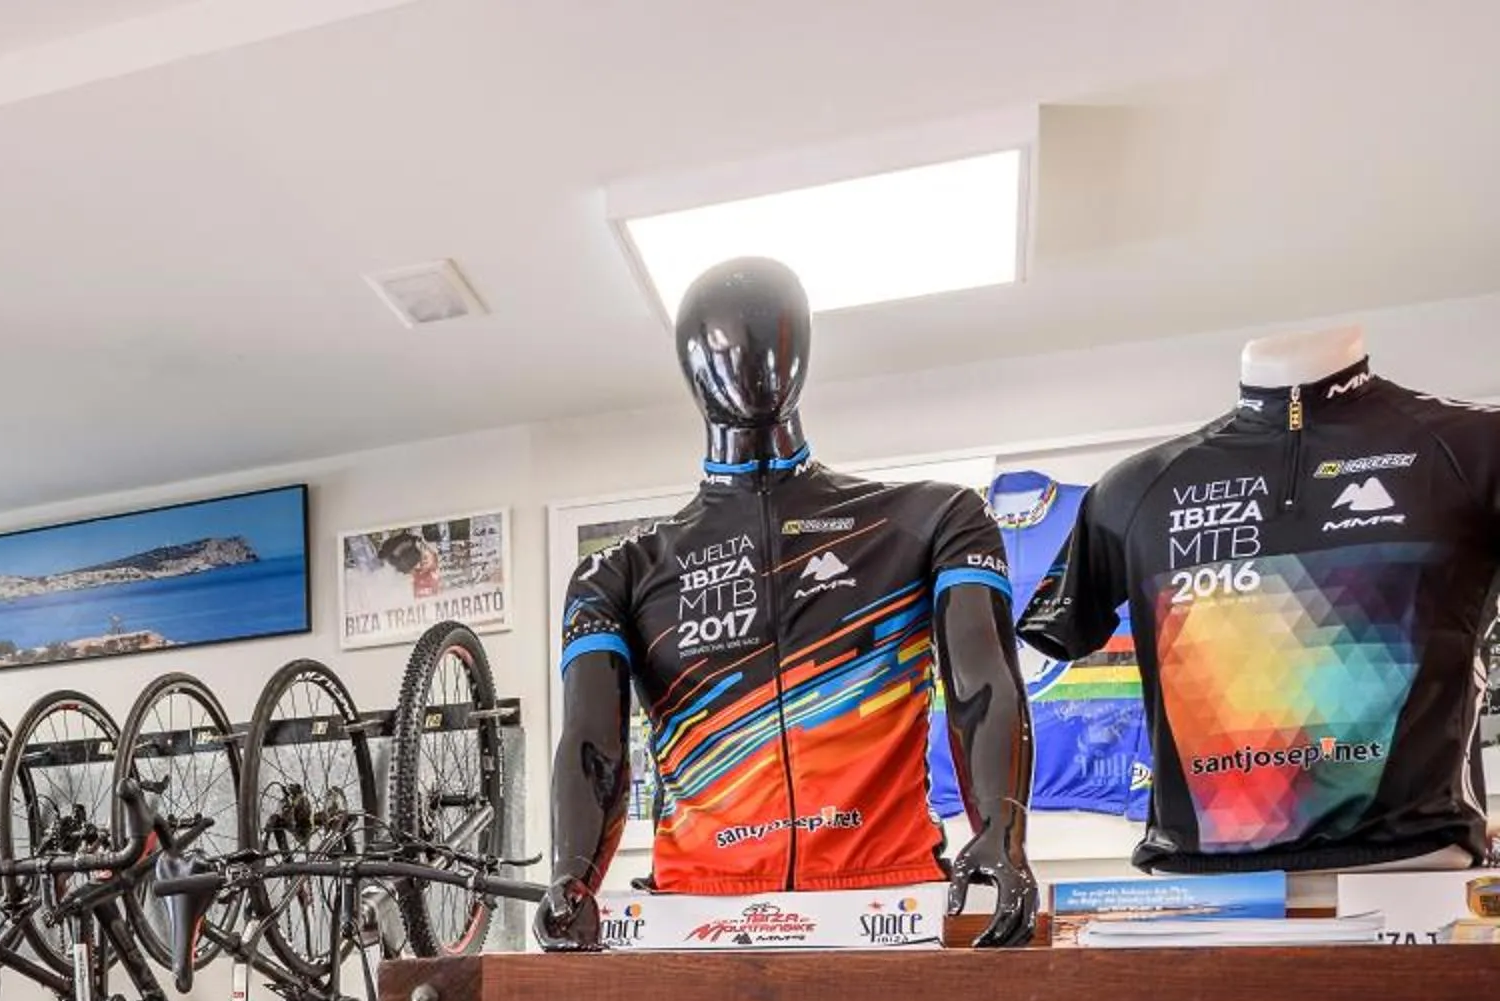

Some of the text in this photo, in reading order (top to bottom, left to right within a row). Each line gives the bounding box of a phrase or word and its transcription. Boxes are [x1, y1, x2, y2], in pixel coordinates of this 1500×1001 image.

[1173, 475, 1269, 505] VUELTA
[1169, 500, 1263, 533] IBIZA
[1322, 514, 1406, 531] MMR
[676, 534, 755, 570] VUELTA
[1170, 525, 1262, 568] MTB
[679, 556, 757, 593] IBIZA
[1171, 562, 1261, 603] 2016
[435, 584, 504, 626] MARATÓ
[678, 578, 757, 620] MTB
[677, 607, 757, 649] 2017
[1192, 738, 1383, 774] santjosep.net
[860, 913, 923, 943] space
